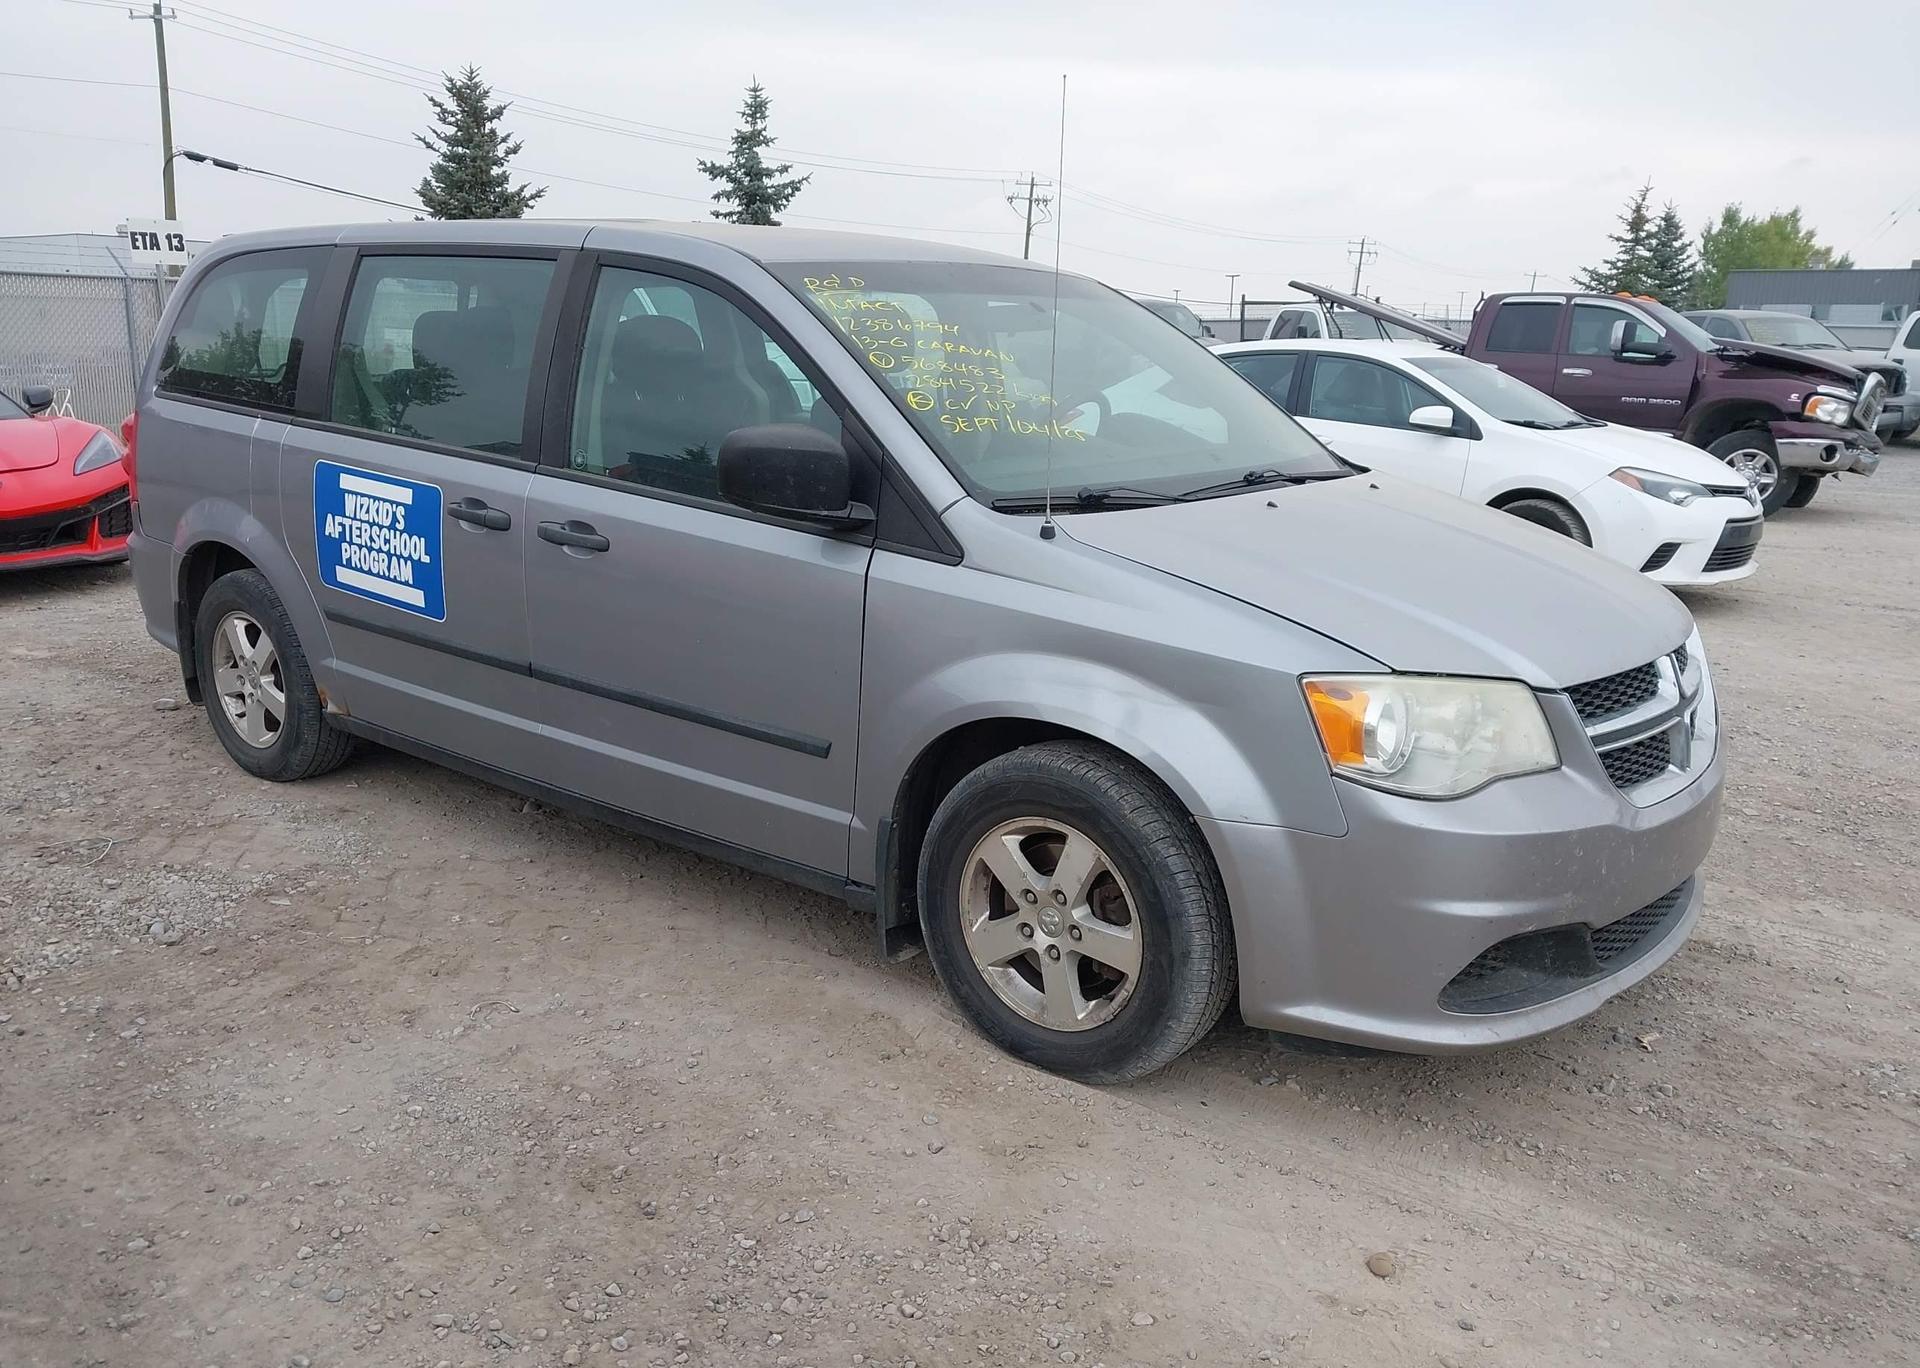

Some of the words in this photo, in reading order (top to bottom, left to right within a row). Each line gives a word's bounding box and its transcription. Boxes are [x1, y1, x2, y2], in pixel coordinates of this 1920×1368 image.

[129, 230, 161, 251] ETA
[165, 232, 185, 252] 13
[818, 298, 904, 312] INTACT
[917, 340, 1015, 362] CARAVAN
[344, 493, 405, 530] WIZKID'S
[324, 513, 431, 564] AFTERSCHOOL
[341, 542, 414, 585] PROGRAM
